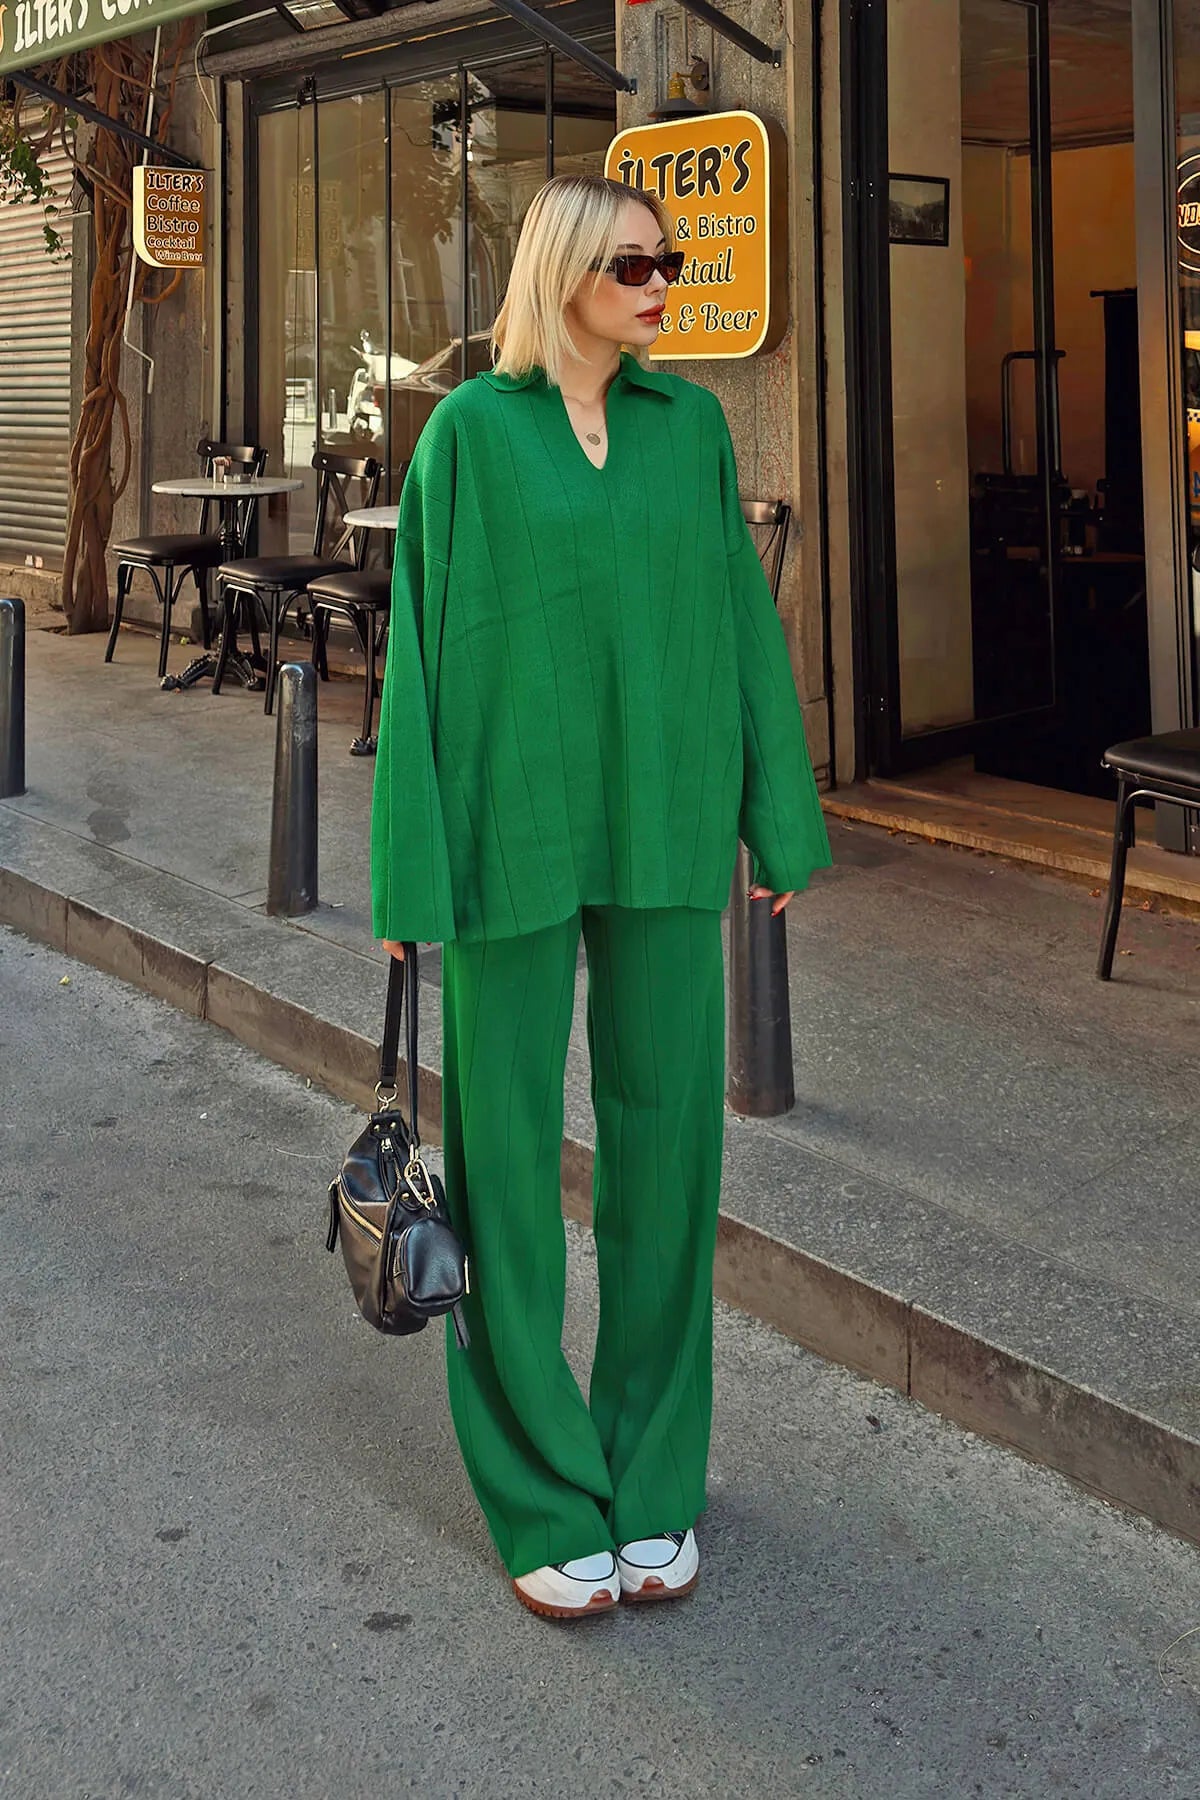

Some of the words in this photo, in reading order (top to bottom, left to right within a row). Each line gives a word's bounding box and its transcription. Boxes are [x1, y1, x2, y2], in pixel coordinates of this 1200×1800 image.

[147, 194, 201, 213] Coffee
[146, 214, 200, 234] Bistro
[676, 216, 692, 241] &
[697, 213, 757, 239] Bistro
[146, 234, 196, 250] Cocktail
[667, 246, 735, 288] ktail
[678, 303, 697, 333] &
[700, 302, 759, 333] Beer
